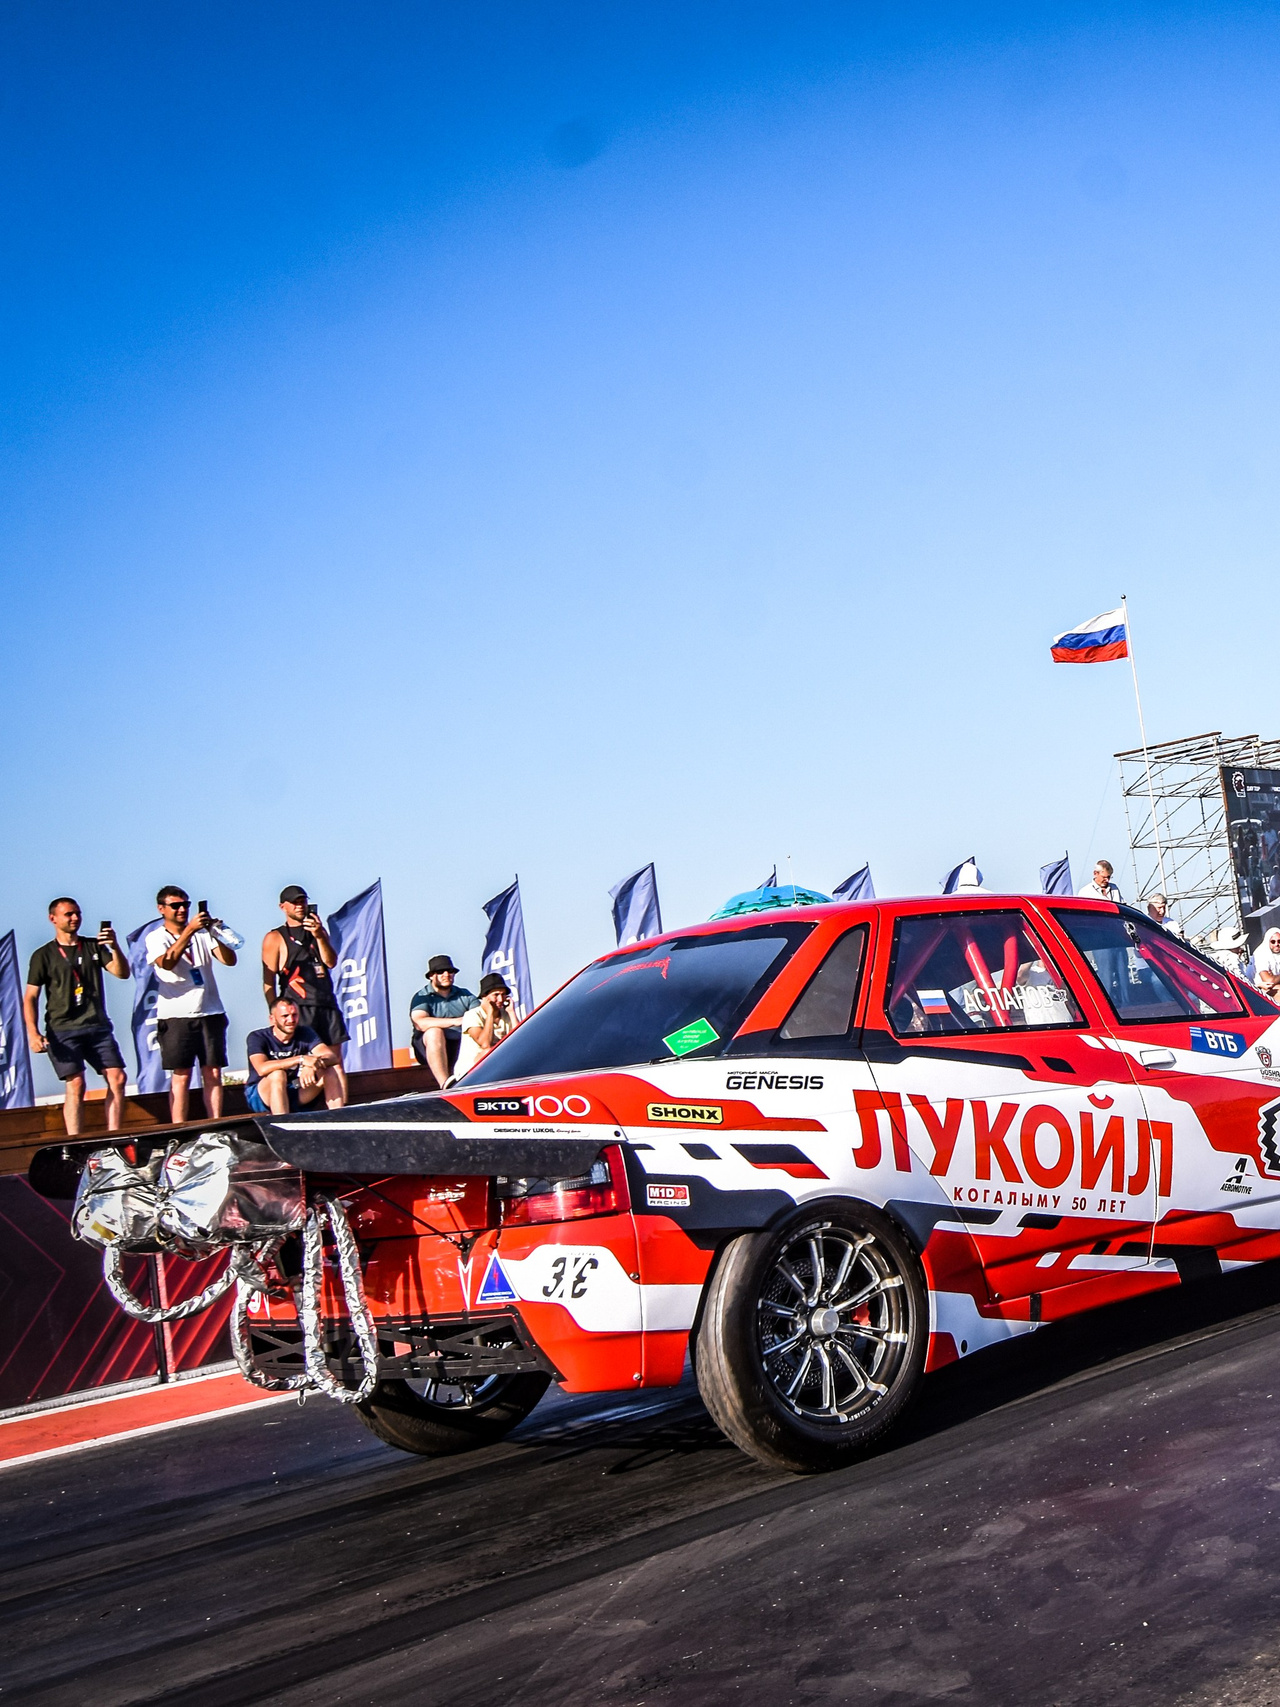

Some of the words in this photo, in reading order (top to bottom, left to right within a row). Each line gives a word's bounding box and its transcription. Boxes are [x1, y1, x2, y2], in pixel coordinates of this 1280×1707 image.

[963, 985, 1054, 1013] АСЛАНОВ
[1204, 1031, 1238, 1053] ВТБ
[726, 1075, 824, 1090] GENESIS
[1260, 1069, 1280, 1078] GOSHA
[477, 1101, 520, 1111] ЭКТО
[521, 1094, 591, 1117] 100
[651, 1106, 719, 1120] SHONX
[851, 1089, 1173, 1198] ЛУКОЙЛ
[649, 1187, 675, 1198] M1D
[1220, 1183, 1252, 1195] AEROMOTIVE
[953, 1186, 1061, 1208] КОГАЛЫМУ
[1071, 1197, 1087, 1211] 50
[1097, 1199, 1126, 1213] ЛЕТ
